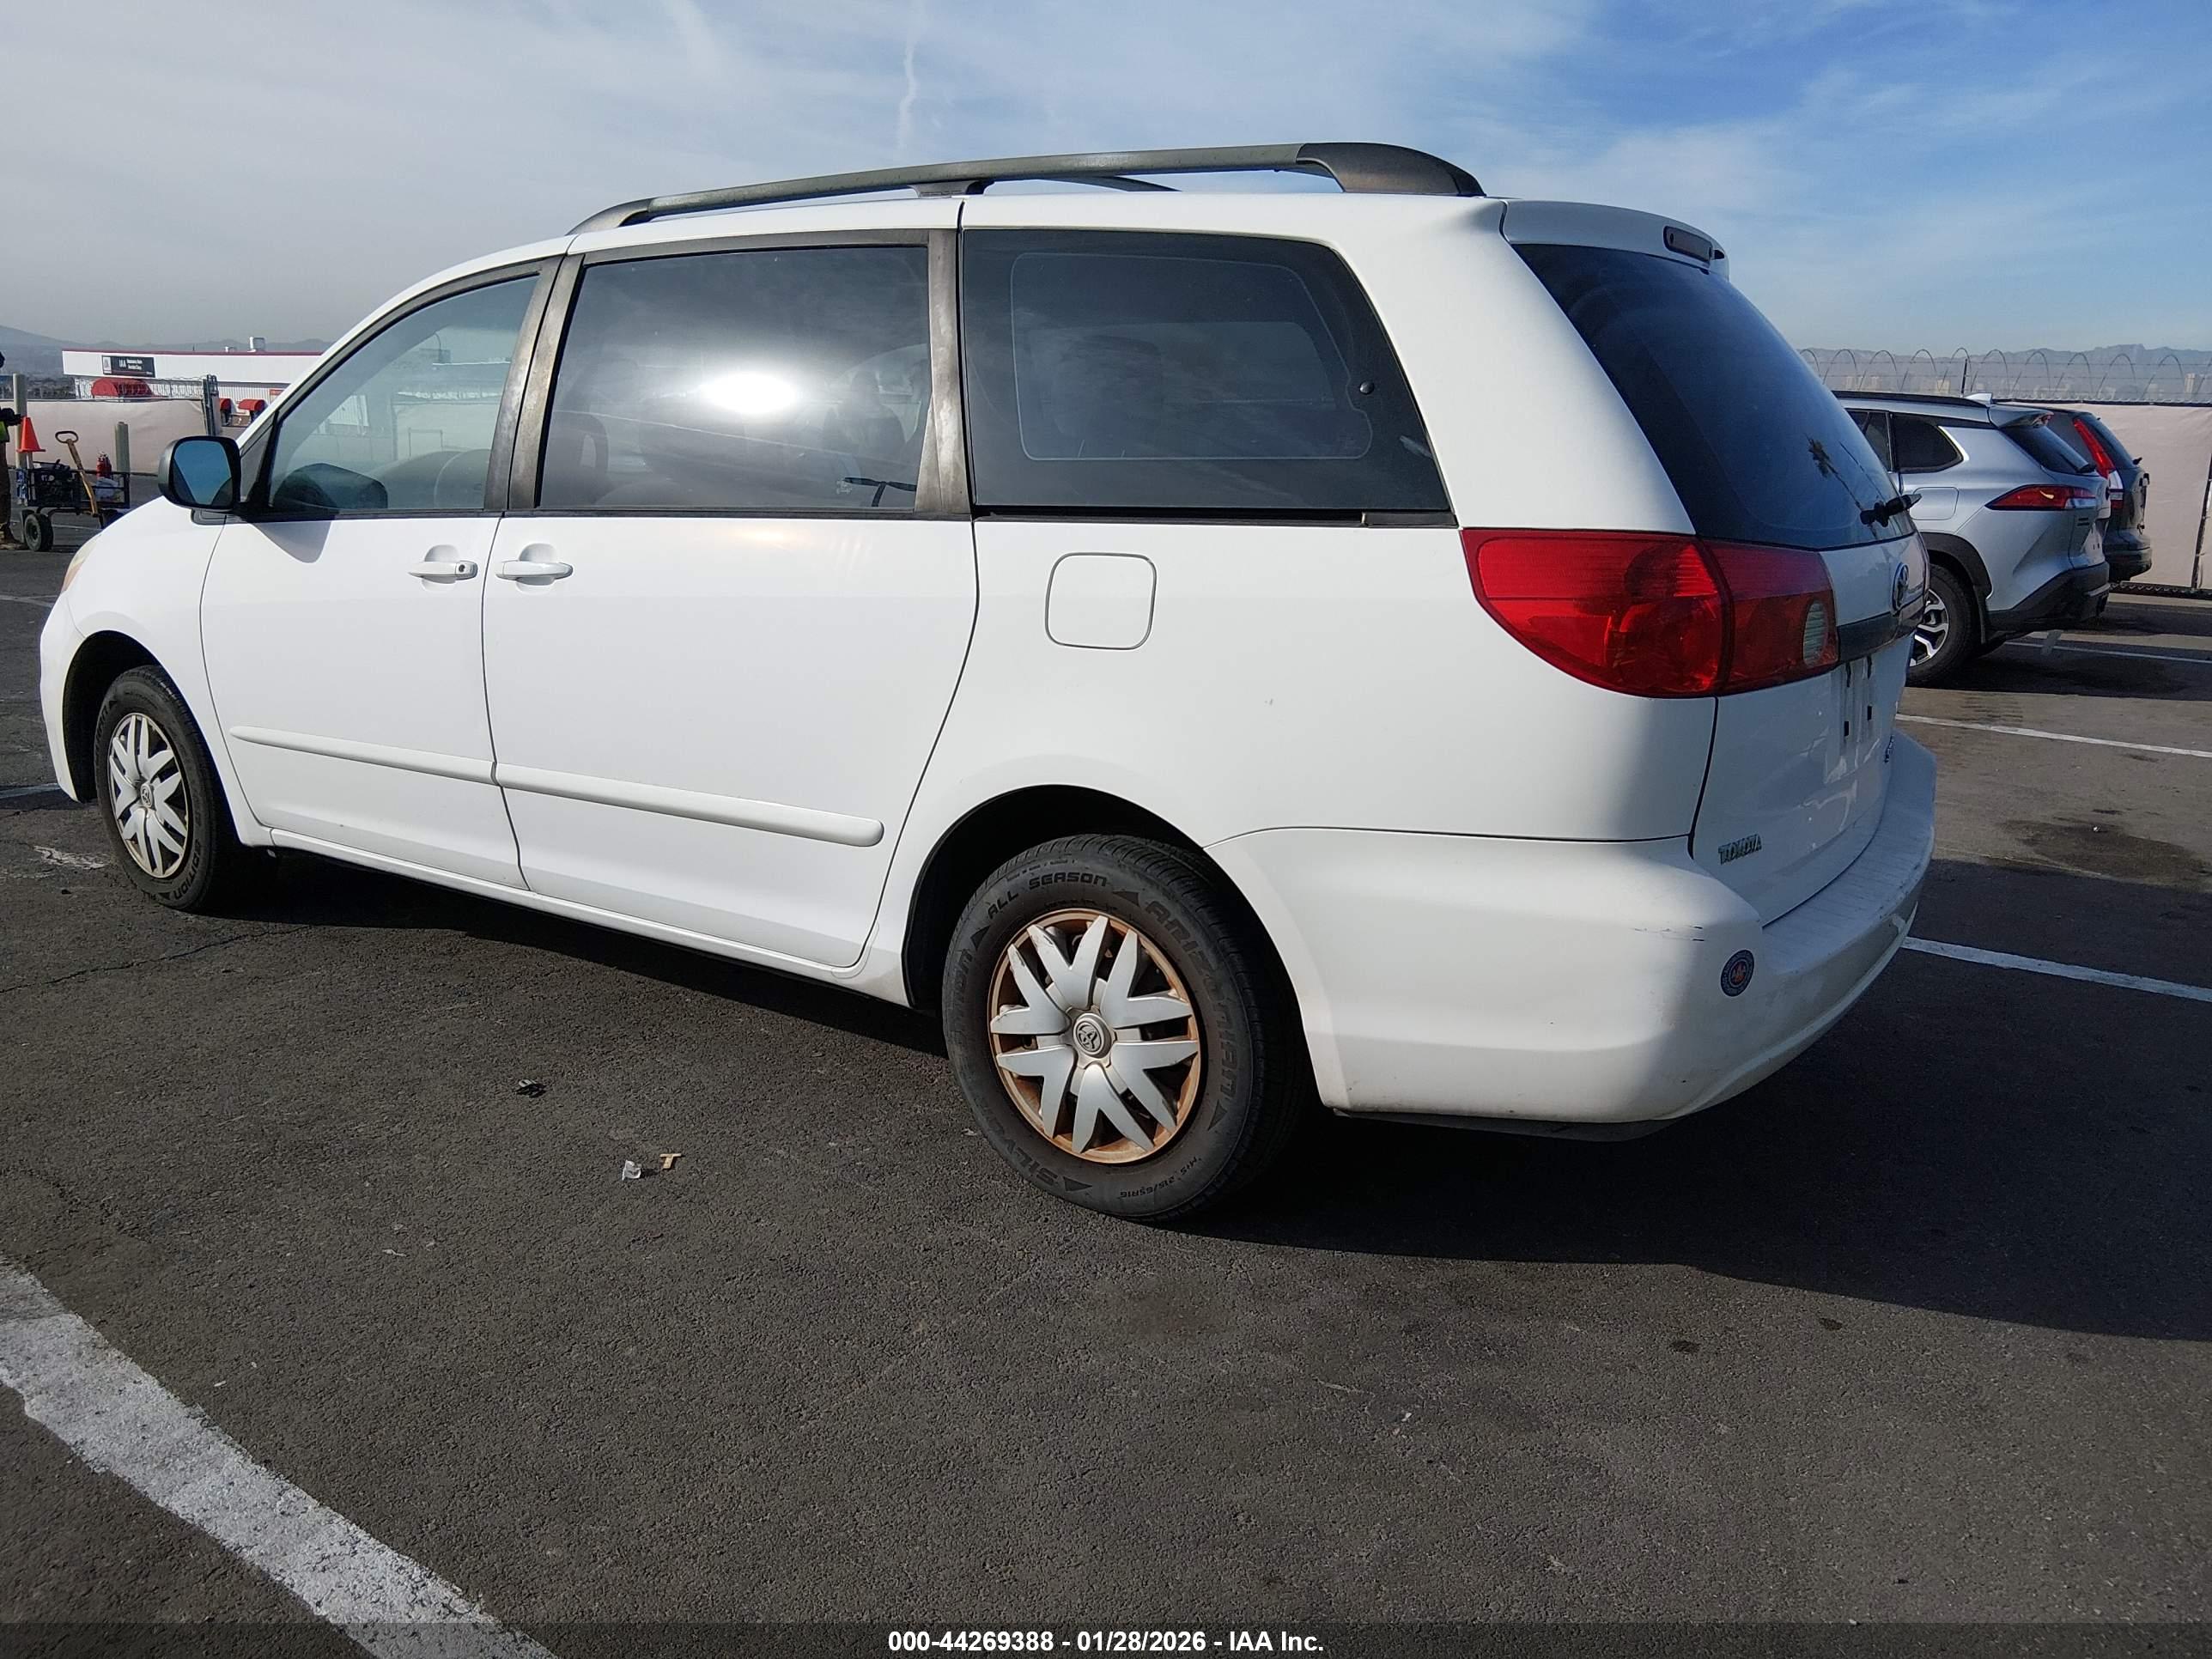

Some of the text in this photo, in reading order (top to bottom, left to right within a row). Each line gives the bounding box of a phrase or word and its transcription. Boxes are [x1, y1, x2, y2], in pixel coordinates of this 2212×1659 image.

[1718, 833, 1762, 866] TOYOTA
[987, 890, 1019, 920] ALL
[1028, 872, 1108, 890] SEASON
